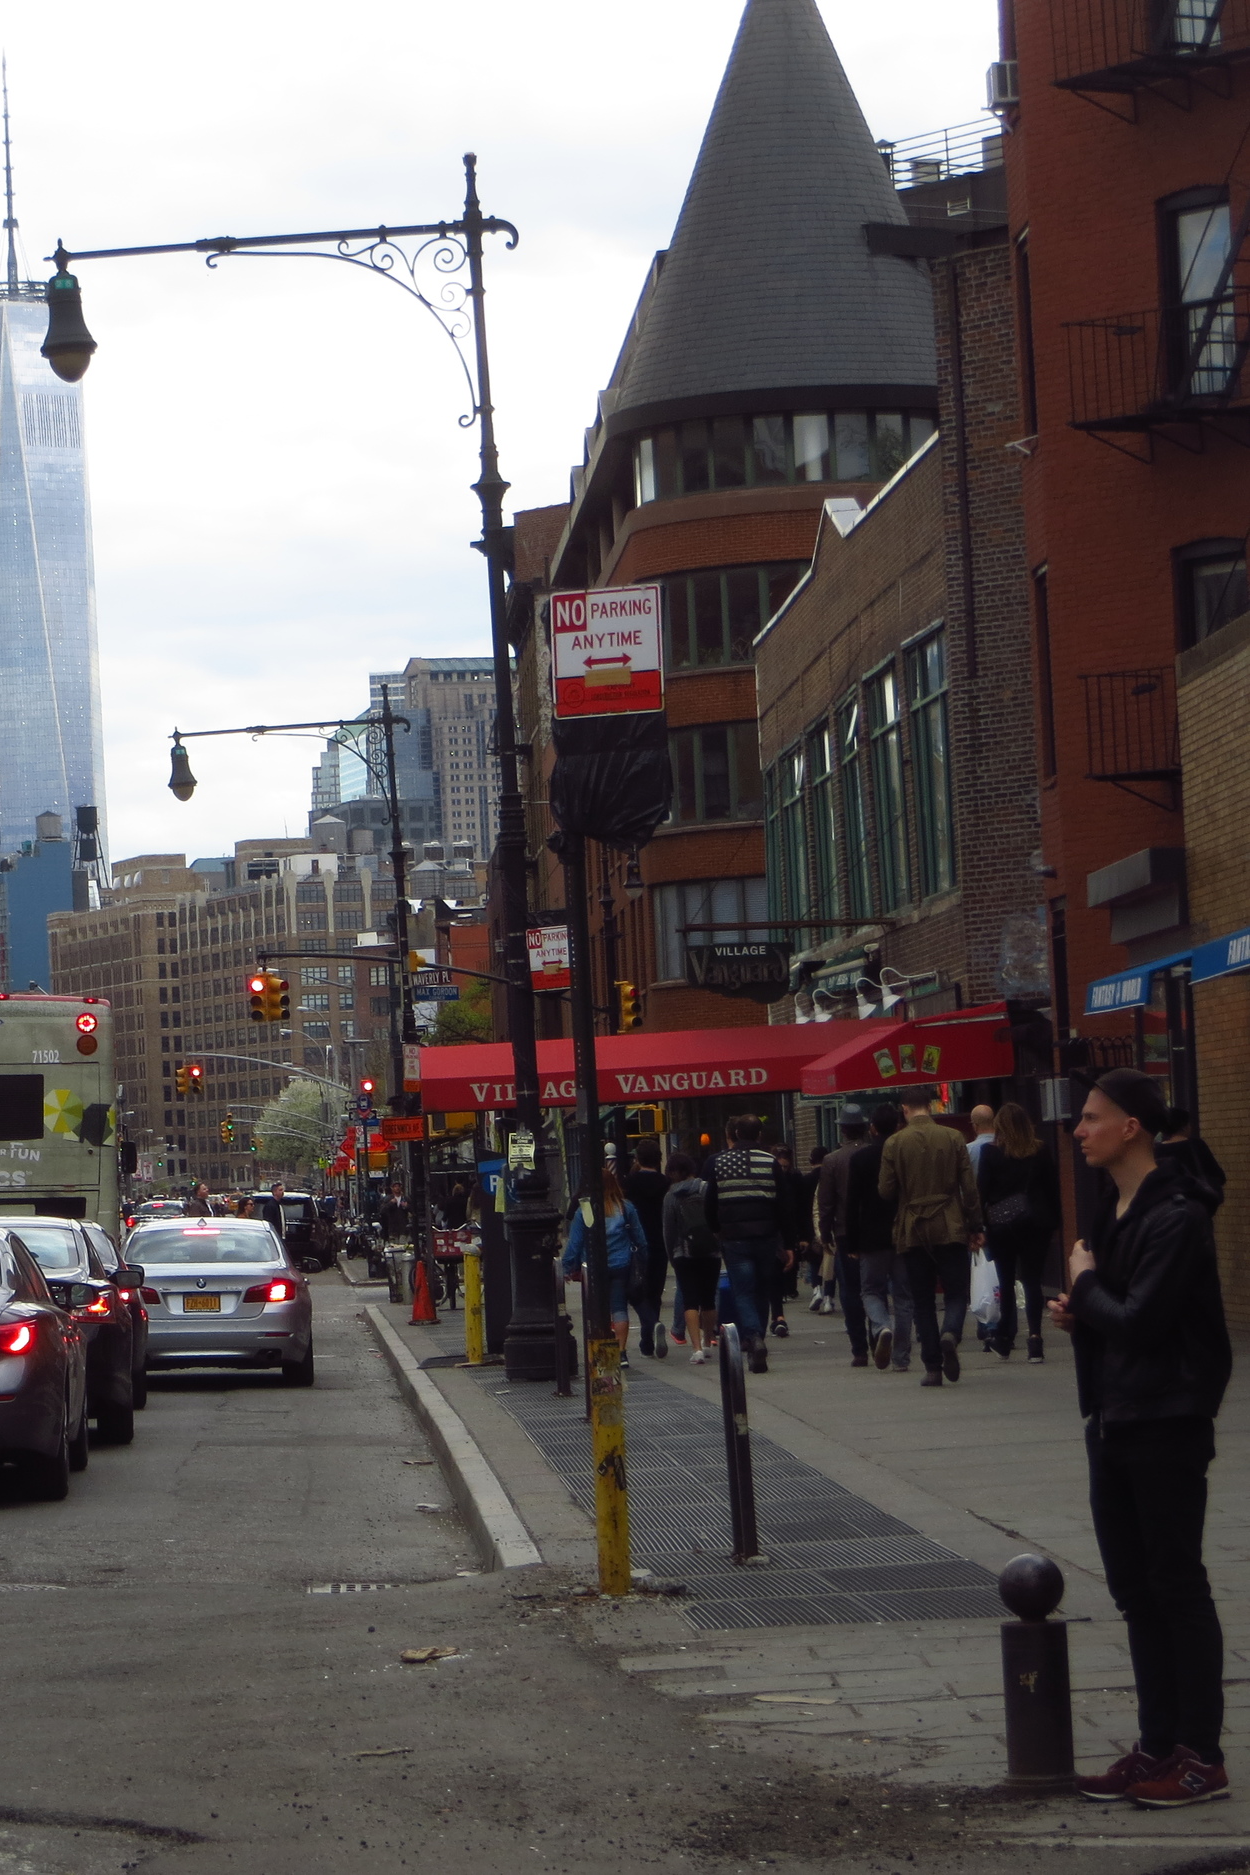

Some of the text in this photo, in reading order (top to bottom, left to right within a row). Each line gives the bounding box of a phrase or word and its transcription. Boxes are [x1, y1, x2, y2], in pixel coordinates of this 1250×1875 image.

[556, 598, 652, 627] NO PARKING
[571, 630, 642, 650] ANYTIME
[528, 931, 566, 947] NO PARKIN
[536, 947, 567, 958] ANYTIME
[715, 945, 766, 956] VILLAGE
[413, 970, 450, 986] WAVERLY PL
[416, 987, 457, 996] MAX GORDON
[32, 1050, 60, 1063] 71502
[470, 1067, 768, 1102] VILAG VANGUARD
[10, 1142, 41, 1161] FUN
